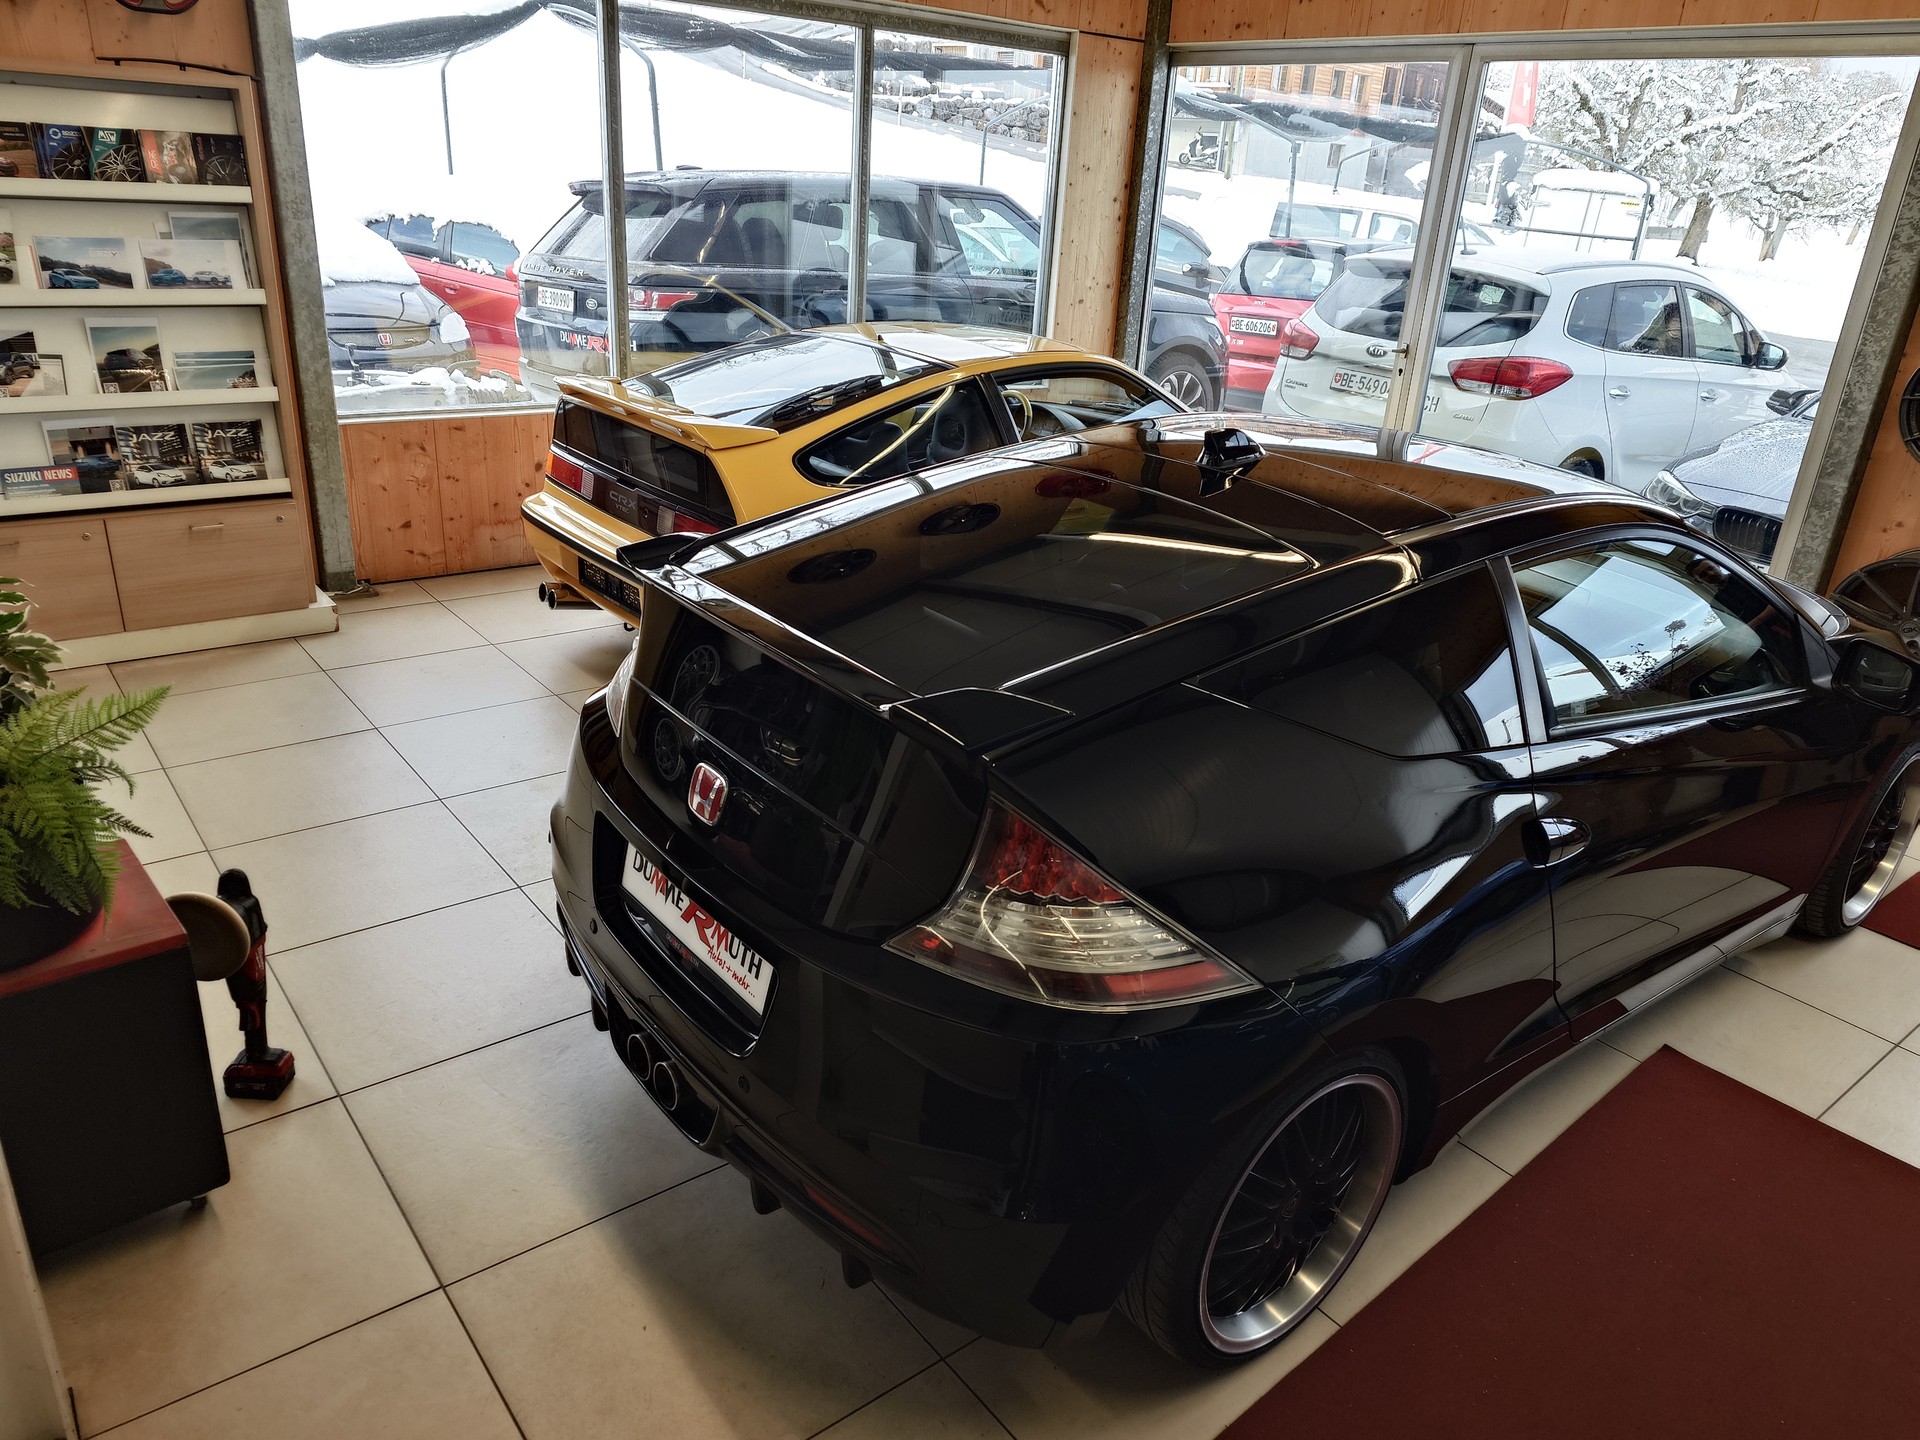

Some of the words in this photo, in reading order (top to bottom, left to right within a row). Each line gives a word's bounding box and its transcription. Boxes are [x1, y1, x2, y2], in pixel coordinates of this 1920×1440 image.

[549, 265, 584, 276] ROVER
[132, 431, 177, 442] JAZZ
[207, 428, 249, 438] JAZZ
[4, 470, 42, 483] SUZUKI
[43, 468, 73, 480] NEWS
[610, 490, 637, 510] CRX
[707, 944, 726, 969] Autos
